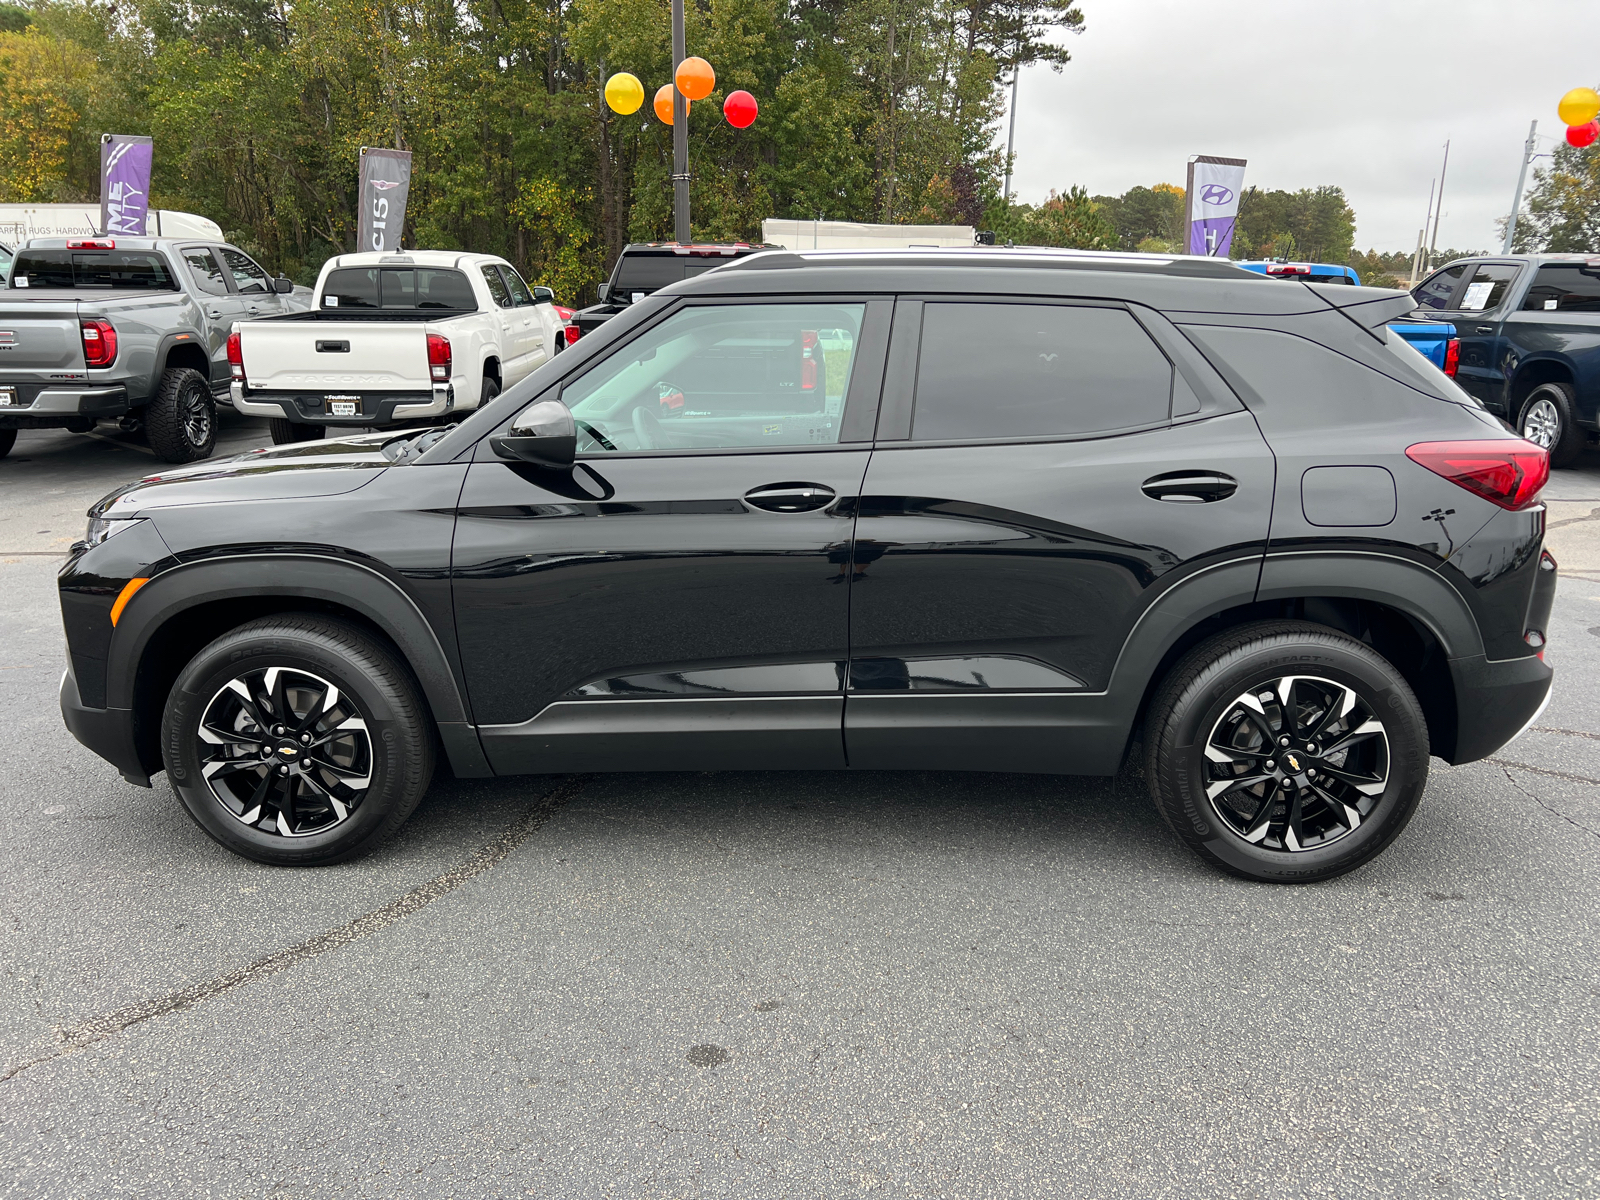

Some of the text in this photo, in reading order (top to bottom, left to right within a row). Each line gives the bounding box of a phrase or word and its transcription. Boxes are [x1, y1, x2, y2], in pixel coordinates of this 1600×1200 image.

[107, 181, 123, 237] ME
[29, 226, 51, 235] RUGS
[285, 375, 393, 383] TACOMA
